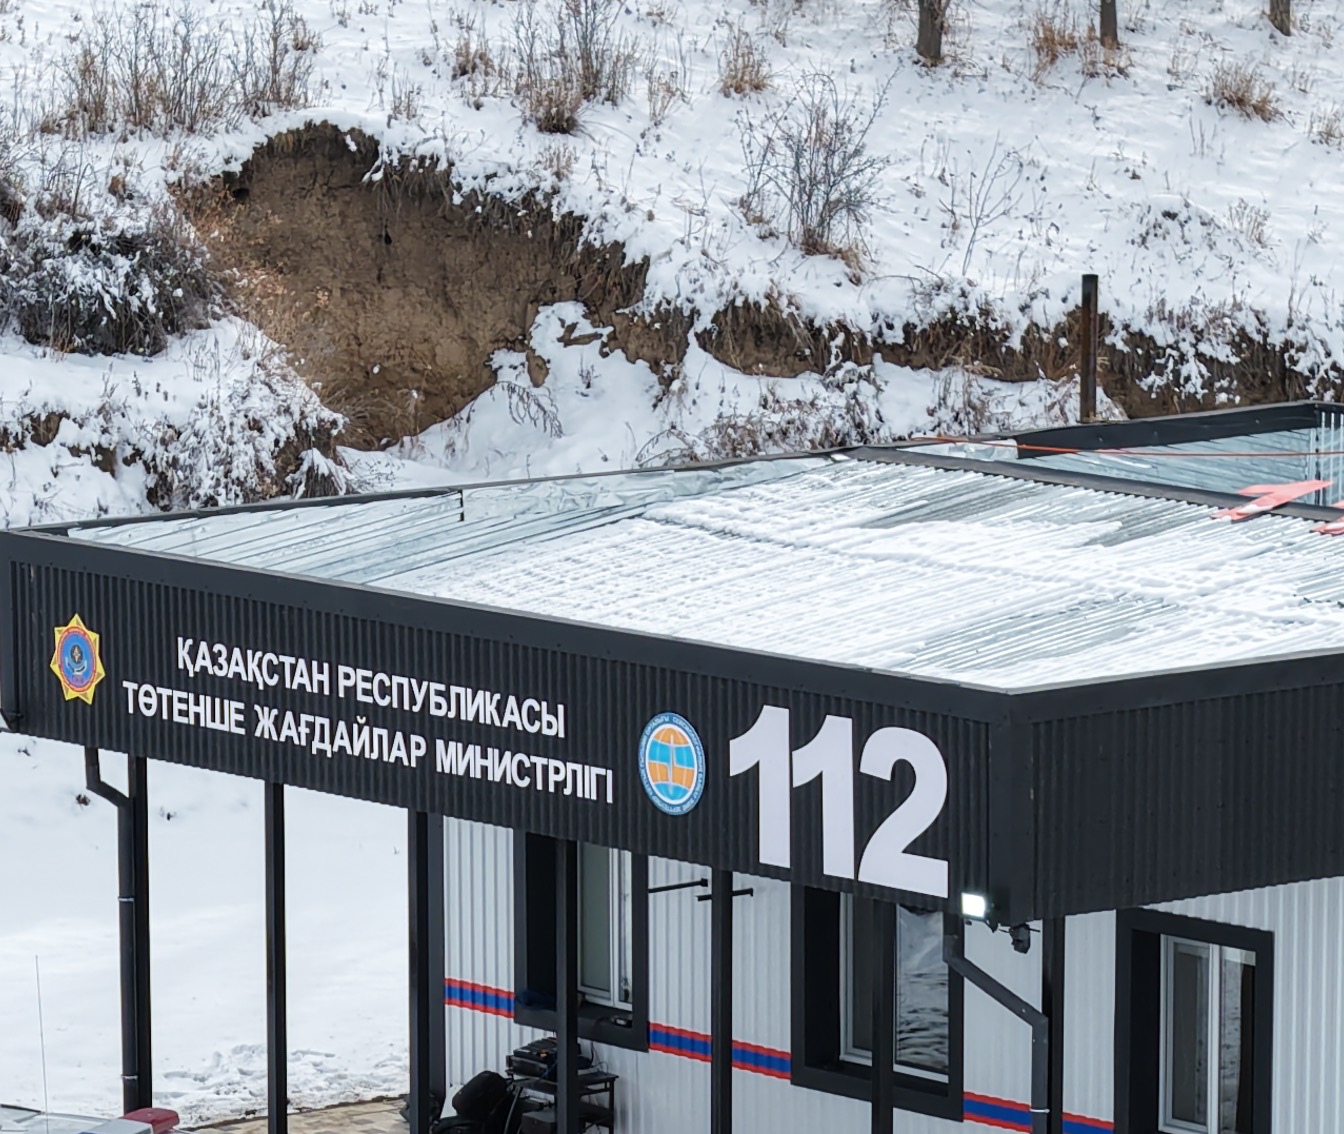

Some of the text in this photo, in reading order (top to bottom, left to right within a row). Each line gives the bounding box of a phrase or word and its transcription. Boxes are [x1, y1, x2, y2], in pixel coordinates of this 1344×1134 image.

[122, 680, 246, 735] ТӨТЕНШЕ
[253, 704, 427, 768] ЖАҒДАЙЛАР
[435, 739, 613, 804] МИНИСТРЛІГІ
[177, 636, 565, 738] ҚАЗАҚСТАН РЕСПУБЛИКАСЫ
[729, 704, 949, 899] 112
